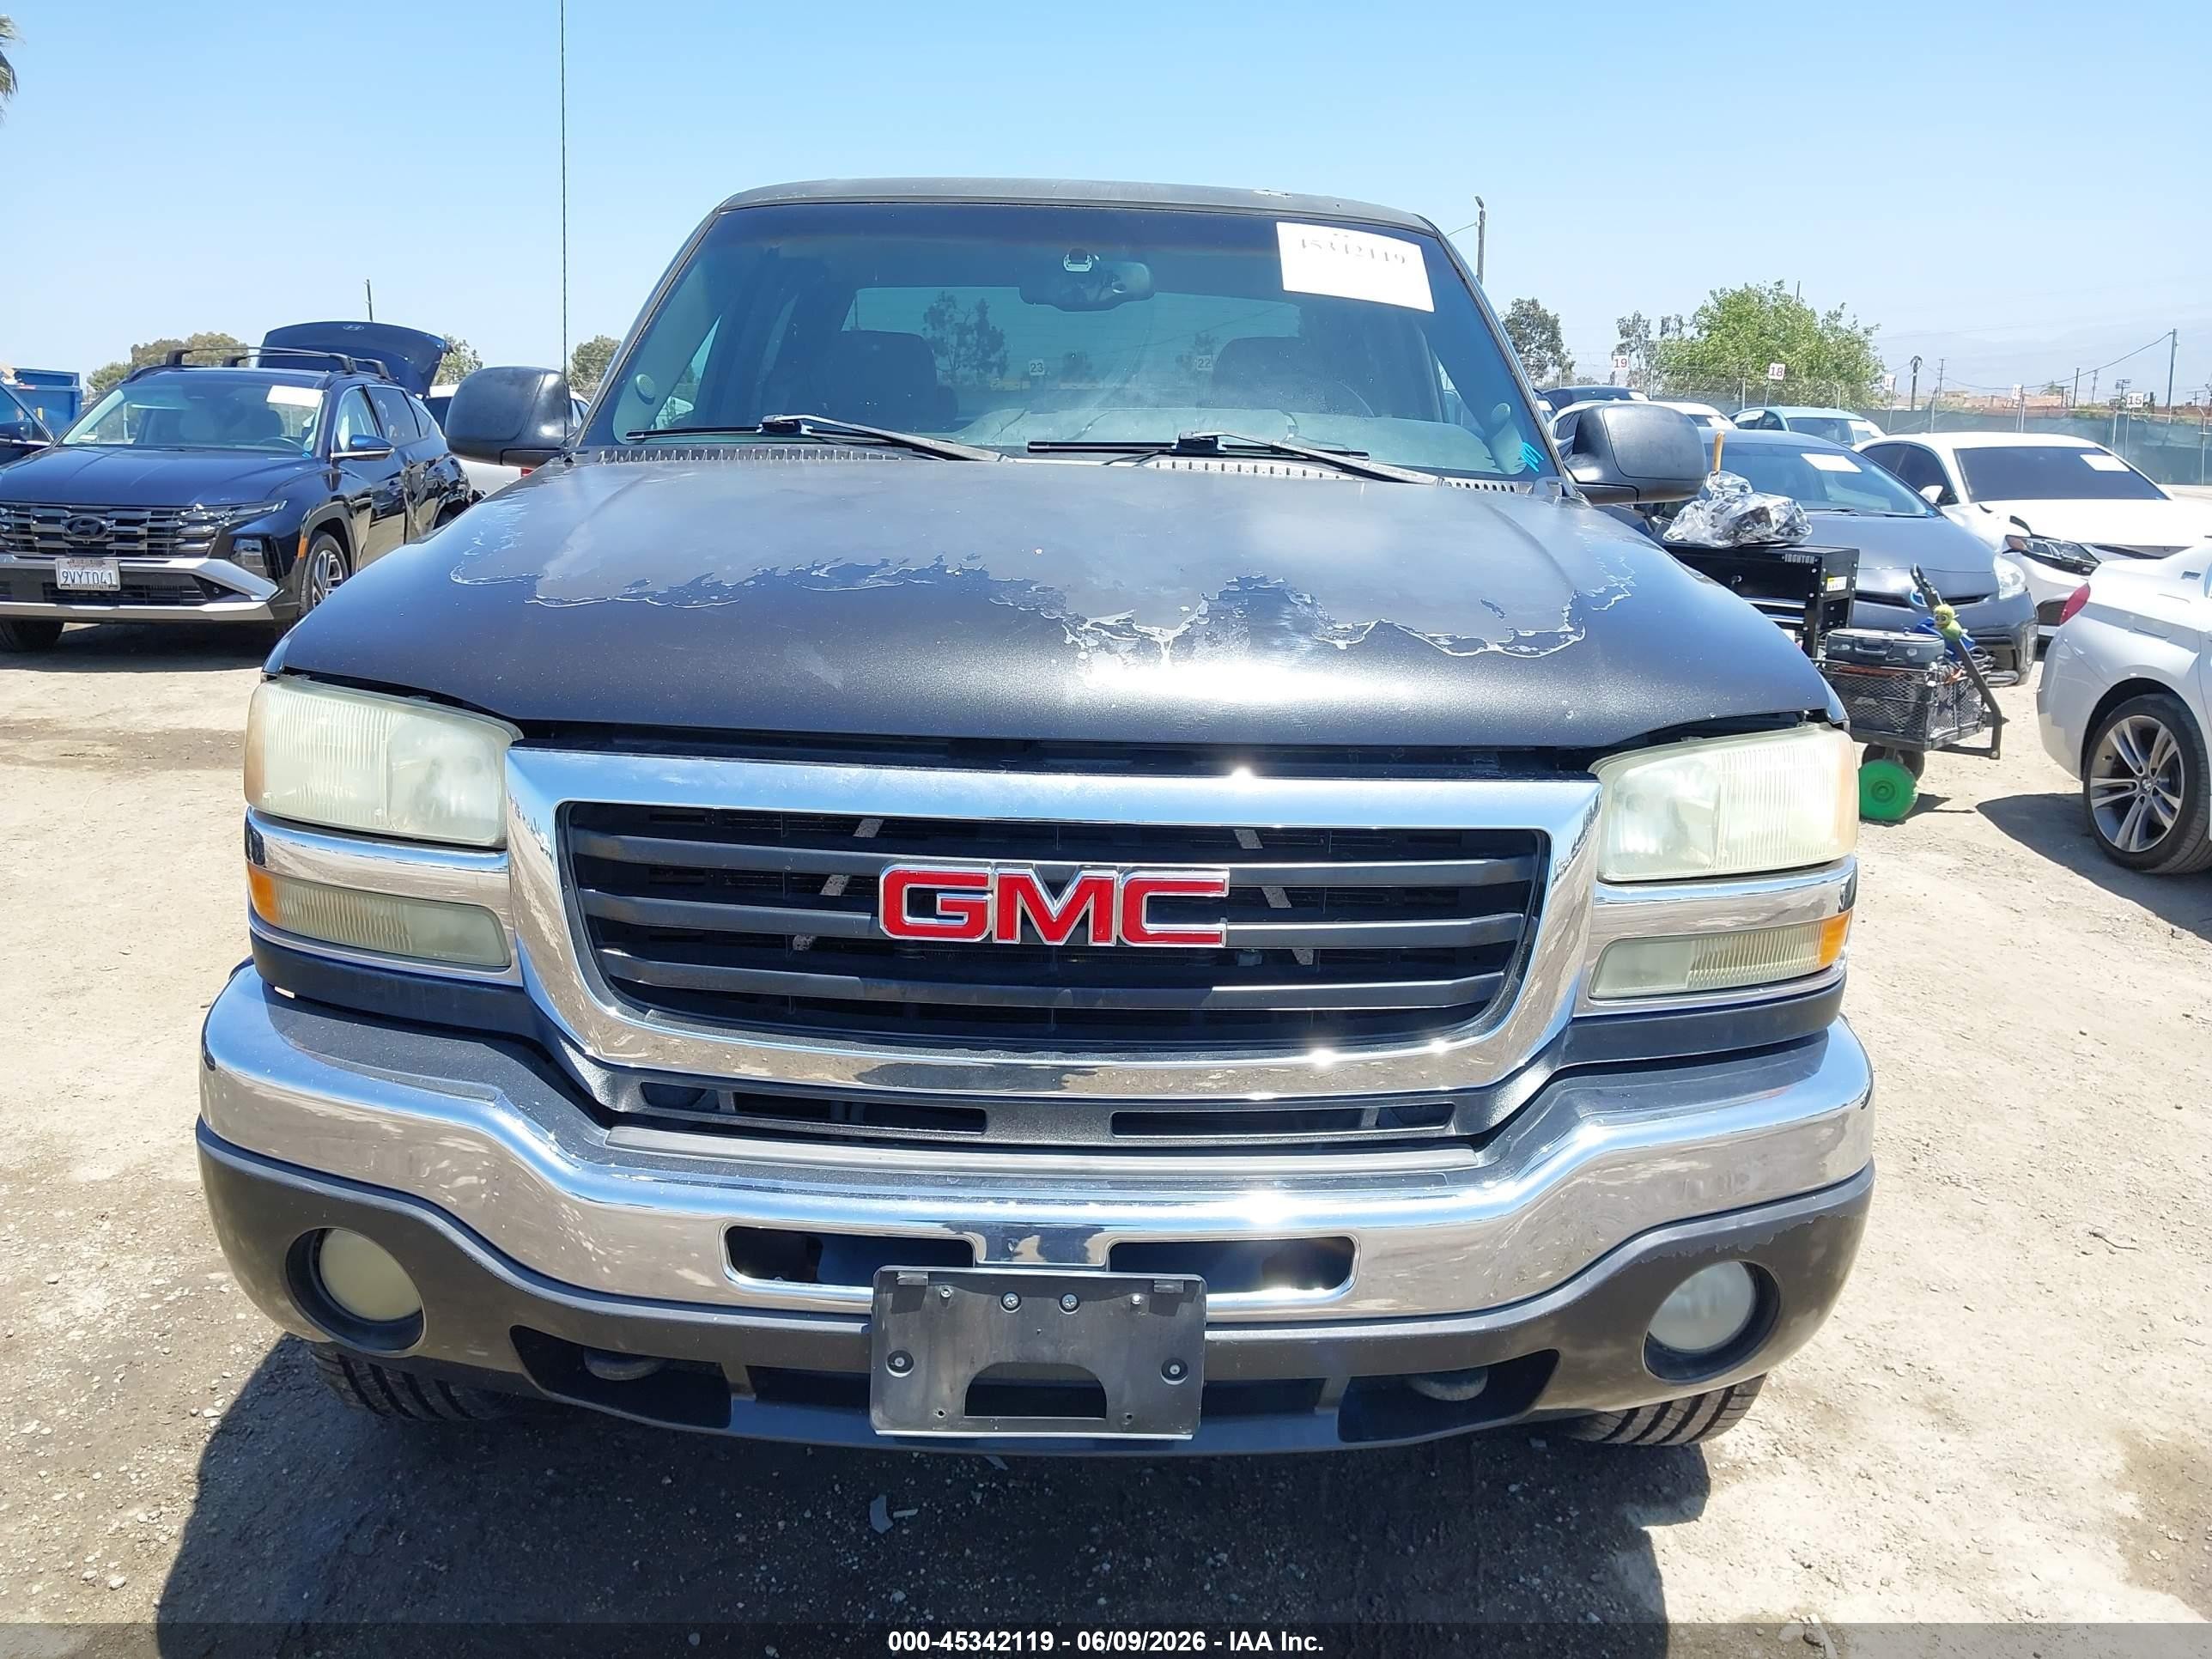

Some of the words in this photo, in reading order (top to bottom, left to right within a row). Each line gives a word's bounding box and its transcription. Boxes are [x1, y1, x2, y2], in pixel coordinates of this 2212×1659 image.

[1030, 362, 1043, 373] 23
[1197, 357, 1212, 368] 22
[1613, 358, 1627, 368] 19
[1769, 367, 1783, 377] 18
[2128, 395, 2142, 405] 15
[61, 570, 113, 585] 9VYT041
[878, 860, 1230, 948] GMC
